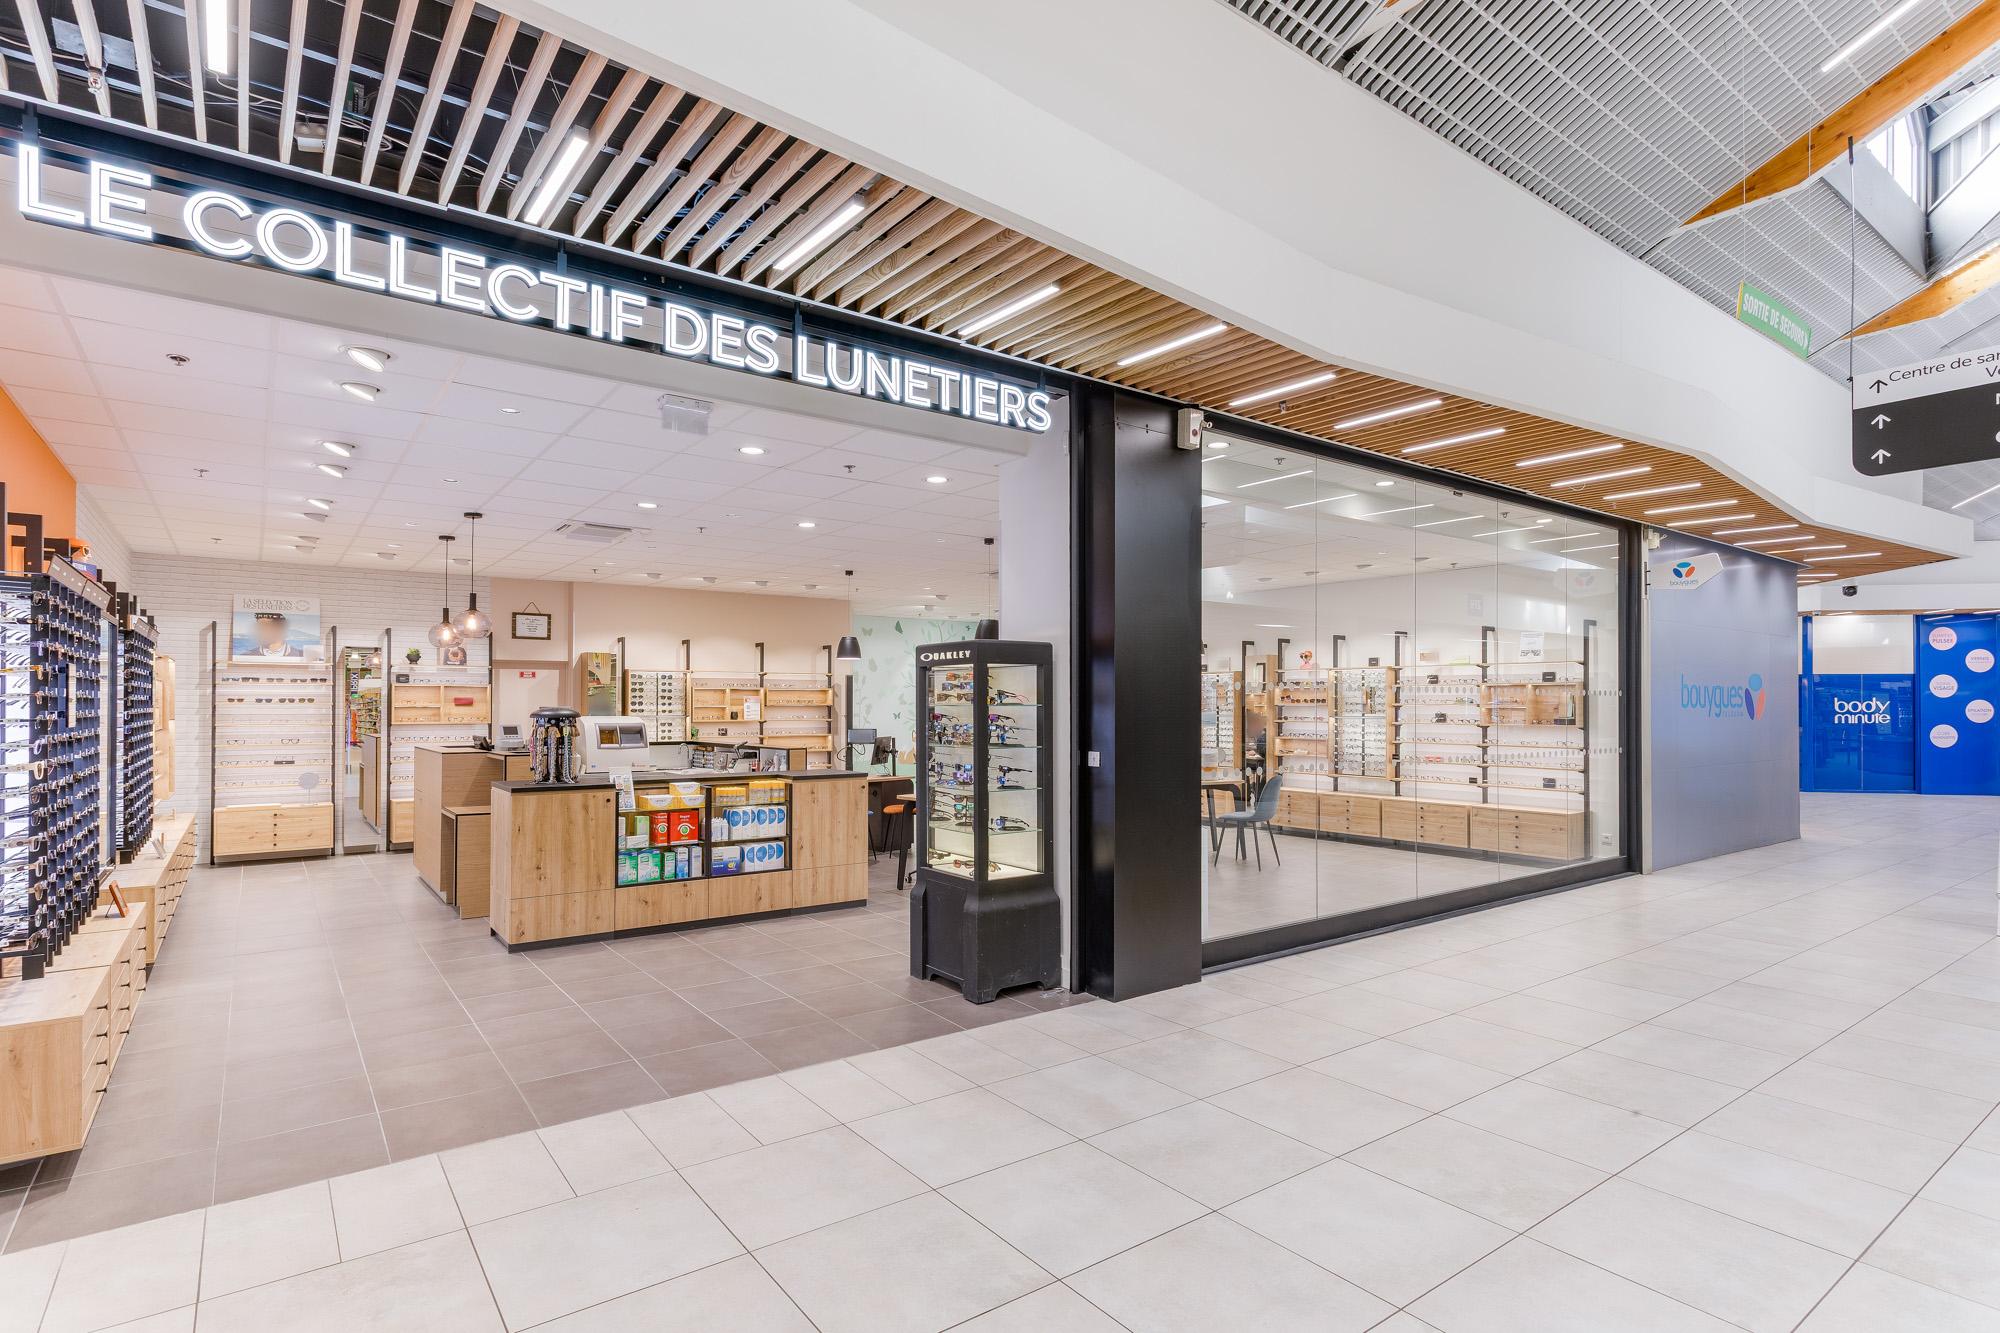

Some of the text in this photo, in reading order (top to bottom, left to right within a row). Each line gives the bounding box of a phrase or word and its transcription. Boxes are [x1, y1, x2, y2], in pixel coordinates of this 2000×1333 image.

[18, 143, 1051, 431] LE COLLECTIF DES LUNETIERS
[1743, 293, 1805, 347] SORTIE DE SECOURS
[1889, 363, 1945, 382] Centre
[1950, 357, 1972, 370] de
[933, 650, 971, 661] OAKLEY
[1681, 673, 1744, 718] bouygues
[1834, 697, 1891, 713] body
[1834, 712, 1891, 724] minute
